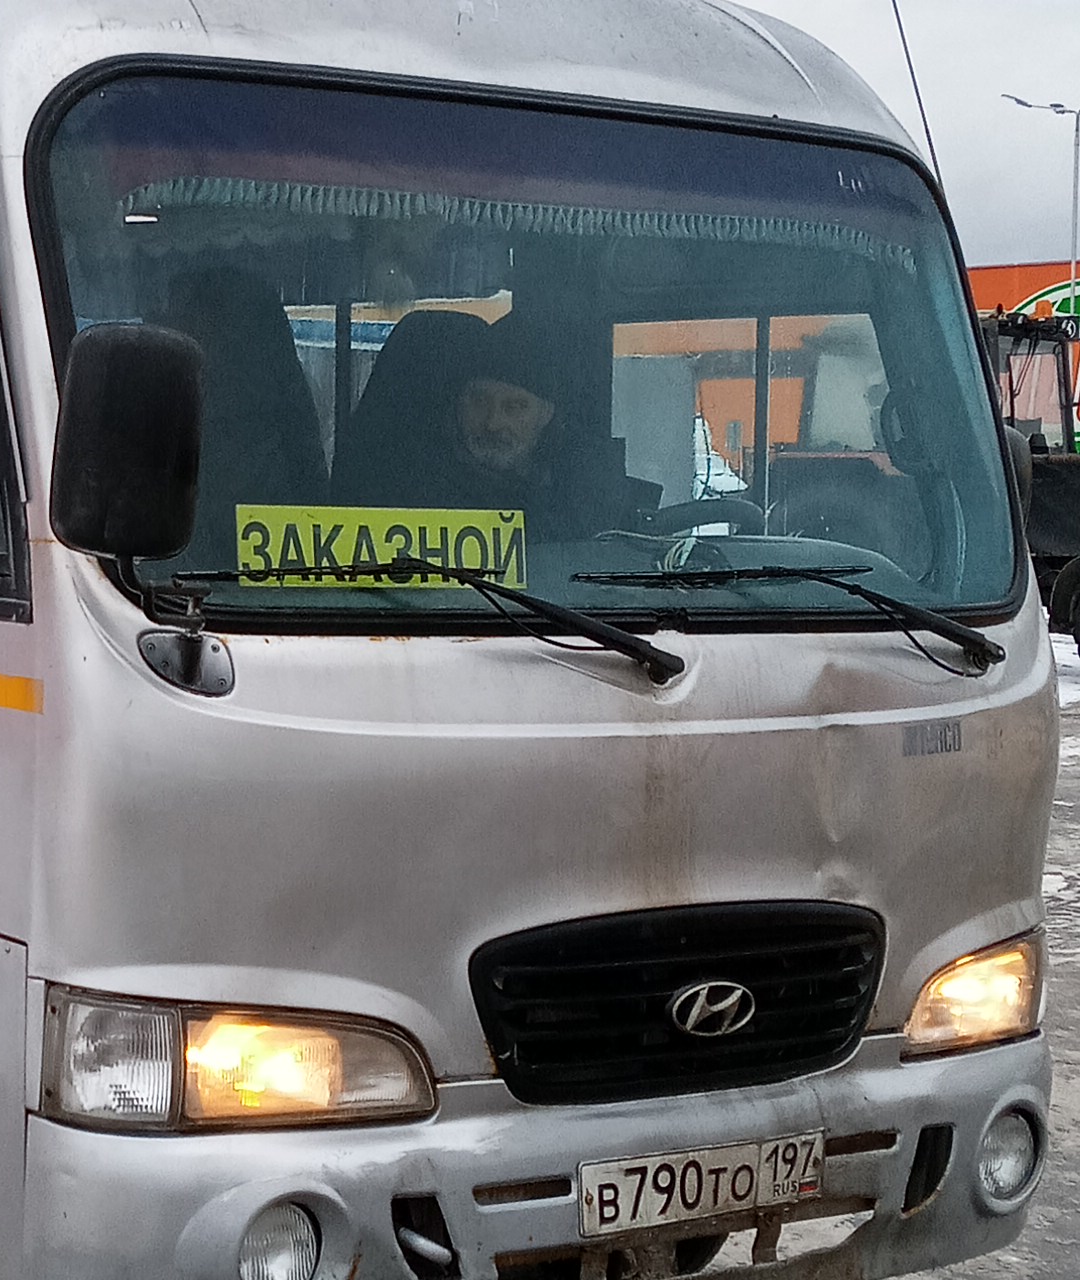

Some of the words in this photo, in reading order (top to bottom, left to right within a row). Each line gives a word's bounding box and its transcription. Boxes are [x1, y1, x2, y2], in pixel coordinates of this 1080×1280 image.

[241, 510, 524, 584] ЗАКАЗНОЙ
[765, 1141, 817, 1182] 197
[773, 1179, 798, 1199] RUS
